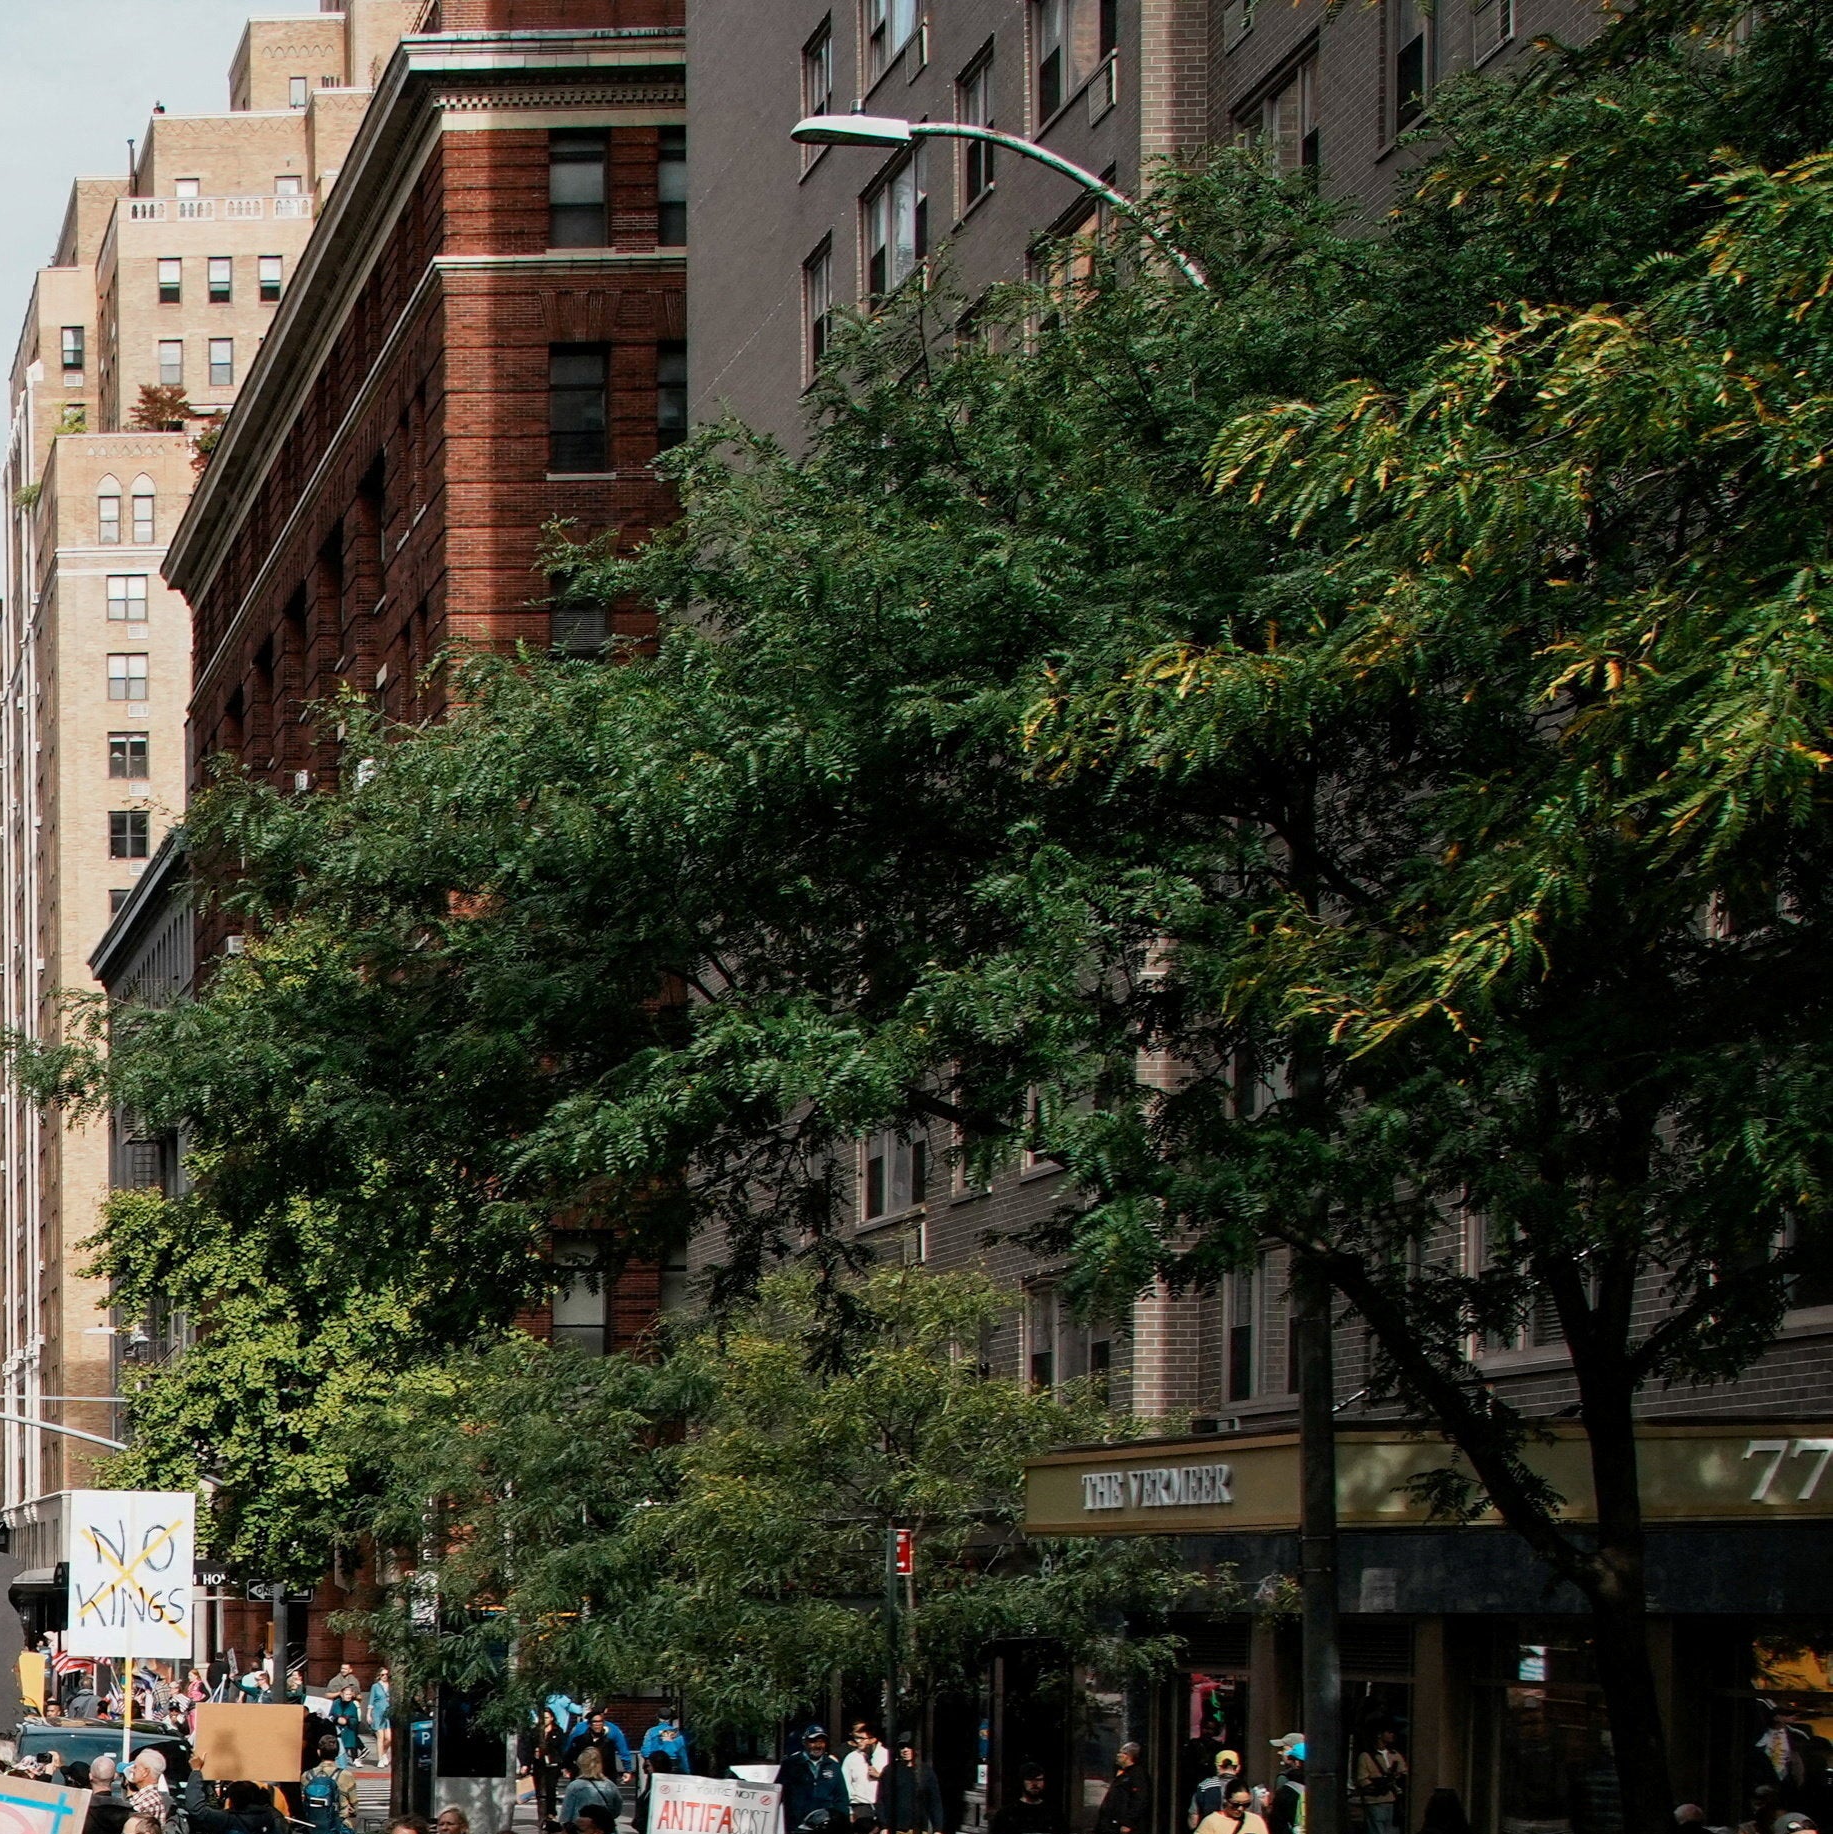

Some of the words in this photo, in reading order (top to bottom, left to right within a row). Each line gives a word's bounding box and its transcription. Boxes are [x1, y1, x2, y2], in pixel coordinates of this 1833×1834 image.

[1082, 1472, 1124, 1510] THE
[1128, 1464, 1233, 1508] VERMEER
[90, 1519, 176, 1572] NO
[75, 1581, 186, 1628] KINGS
[422, 1731, 431, 1745] P
[736, 1790, 758, 1800] NOT
